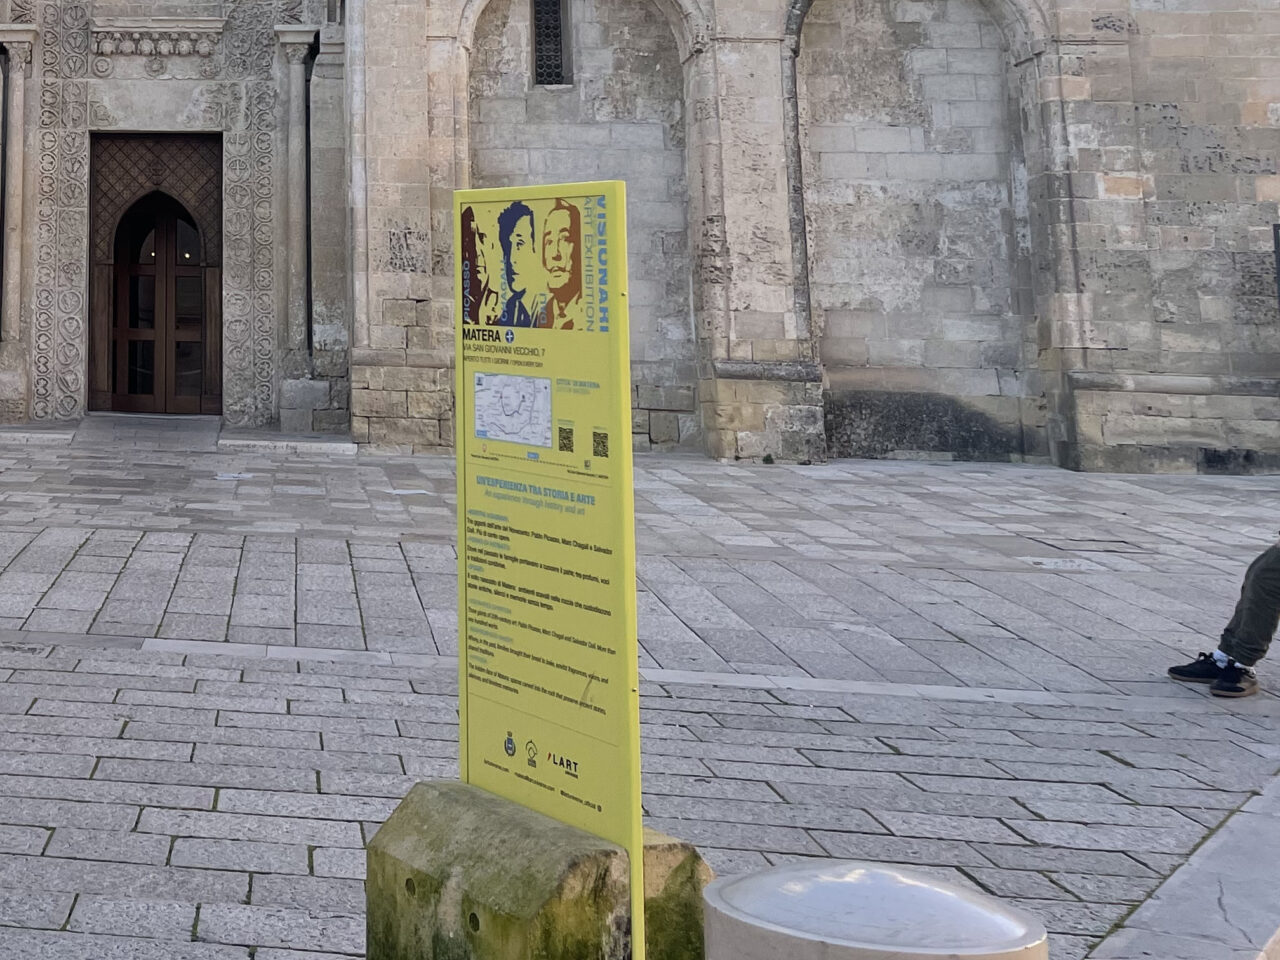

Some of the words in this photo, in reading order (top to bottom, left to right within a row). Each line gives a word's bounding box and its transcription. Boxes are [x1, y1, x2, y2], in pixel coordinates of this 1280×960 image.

[583, 196, 593, 227] ART
[584, 233, 595, 333] EXHIBITION
[597, 195, 609, 333] VISIONARI
[463, 260, 471, 321] PICASSO
[500, 255, 508, 322] CHAGALL
[463, 328, 501, 342] MATERA
[463, 343, 472, 351] VIA
[473, 344, 484, 352] SAN
[485, 344, 512, 355] GIOVANNI
[528, 484, 542, 496] TRA
[543, 487, 569, 500] STORIA
[570, 491, 575, 502] E
[576, 493, 596, 505] ARTE
